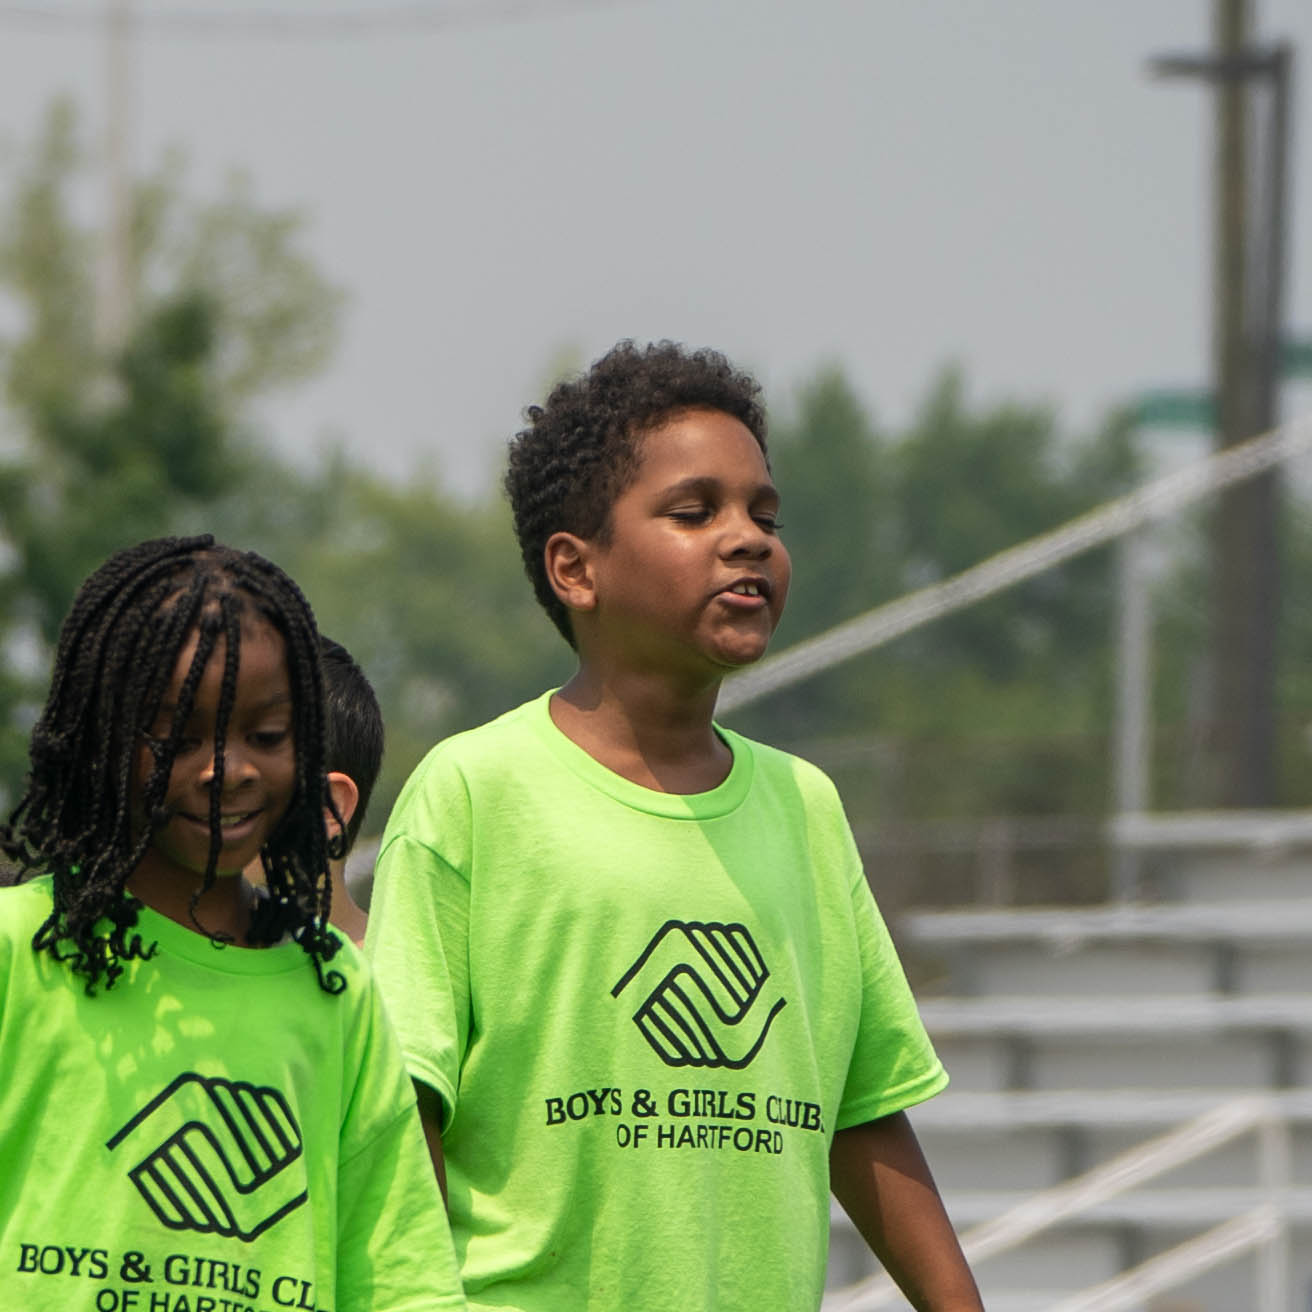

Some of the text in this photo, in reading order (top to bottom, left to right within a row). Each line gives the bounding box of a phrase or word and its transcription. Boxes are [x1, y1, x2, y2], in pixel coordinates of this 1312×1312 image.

[545, 1088, 622, 1126] BOYS
[632, 1089, 657, 1118] &
[668, 1089, 756, 1121] GIRLS
[616, 1125, 783, 1155] OF HARTFORD
[16, 1243, 109, 1279] BOYS
[119, 1250, 153, 1283] &
[164, 1254, 260, 1299] GIRLS
